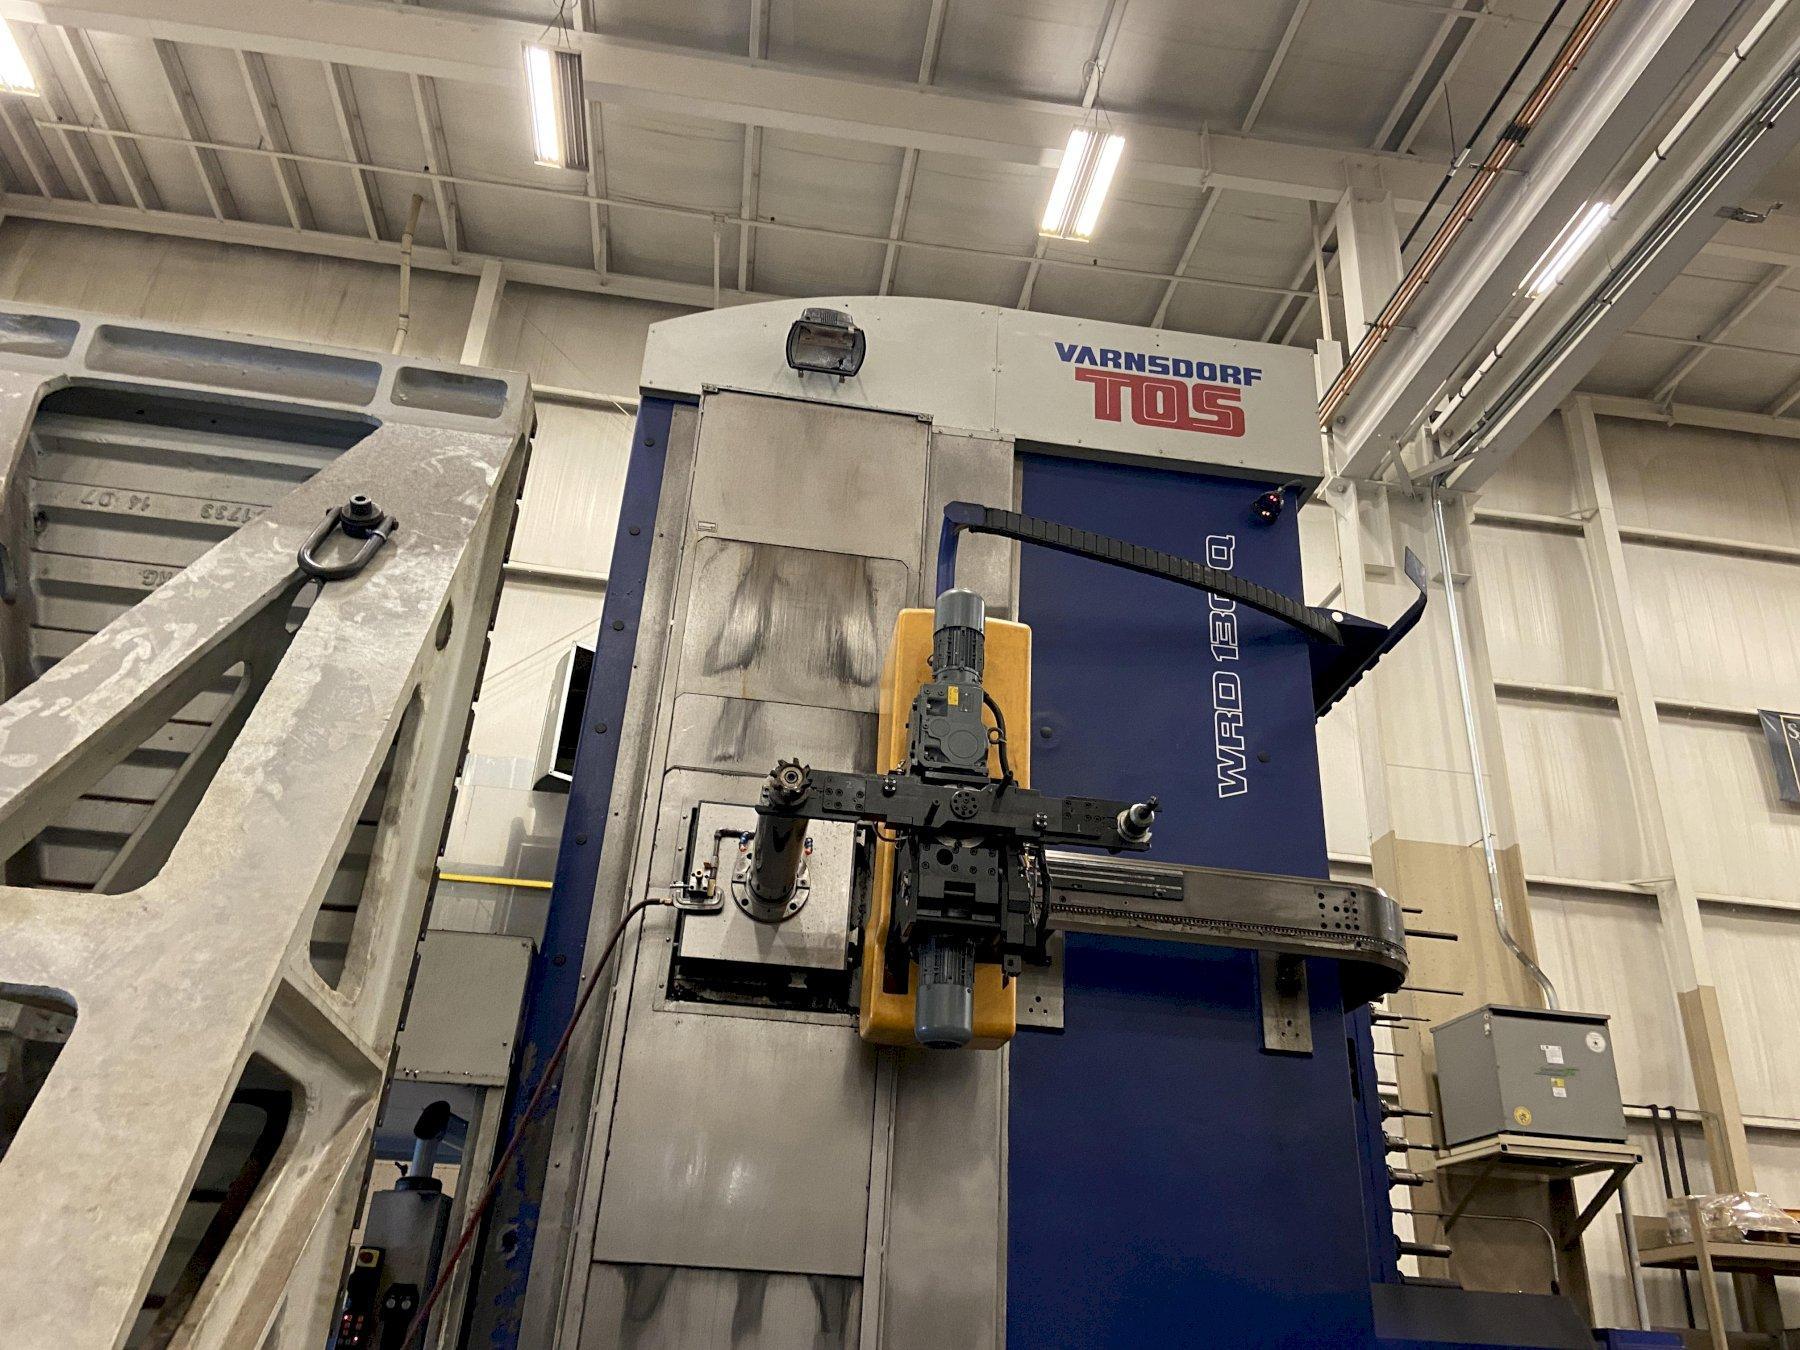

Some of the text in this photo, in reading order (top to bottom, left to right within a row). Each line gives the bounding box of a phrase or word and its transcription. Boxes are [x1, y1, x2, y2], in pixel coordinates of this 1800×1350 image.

[1054, 342, 1262, 386] VARNSDORF
[1075, 367, 1246, 438] TOS
[1206, 535, 1235, 570] Q
[1213, 671, 1247, 798] WRD
